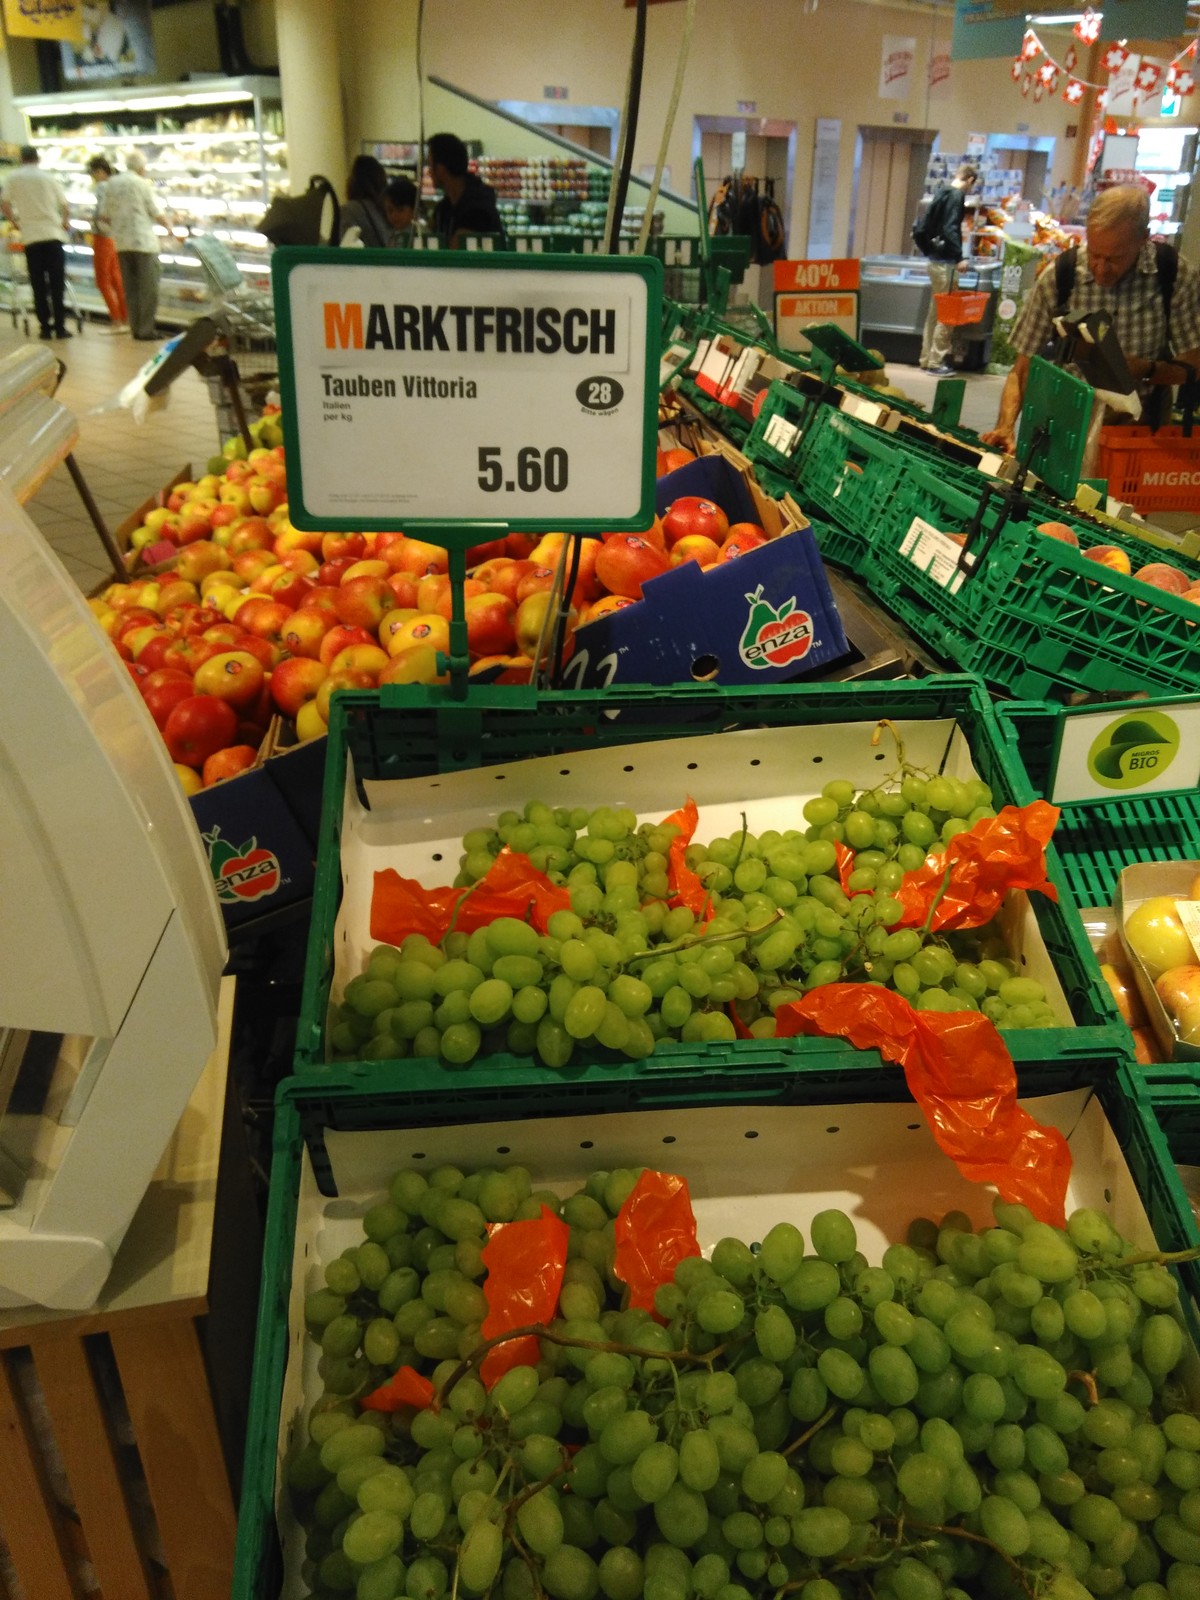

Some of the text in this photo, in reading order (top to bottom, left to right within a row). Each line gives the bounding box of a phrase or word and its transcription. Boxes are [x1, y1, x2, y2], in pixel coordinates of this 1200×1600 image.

[795, 264, 839, 287] 40%
[795, 300, 837, 315] AKTION
[323, 303, 616, 354] MARKTFRISCH
[321, 374, 477, 399] Tauben Vittoria
[588, 382, 612, 404] 28
[322, 401, 351, 410] Italien
[323, 412, 353, 422] per kg
[478, 446, 568, 493] 5.60
[744, 624, 811, 660] enza
[1129, 756, 1158, 771] BIO
[1131, 749, 1160, 757] MIGROS
